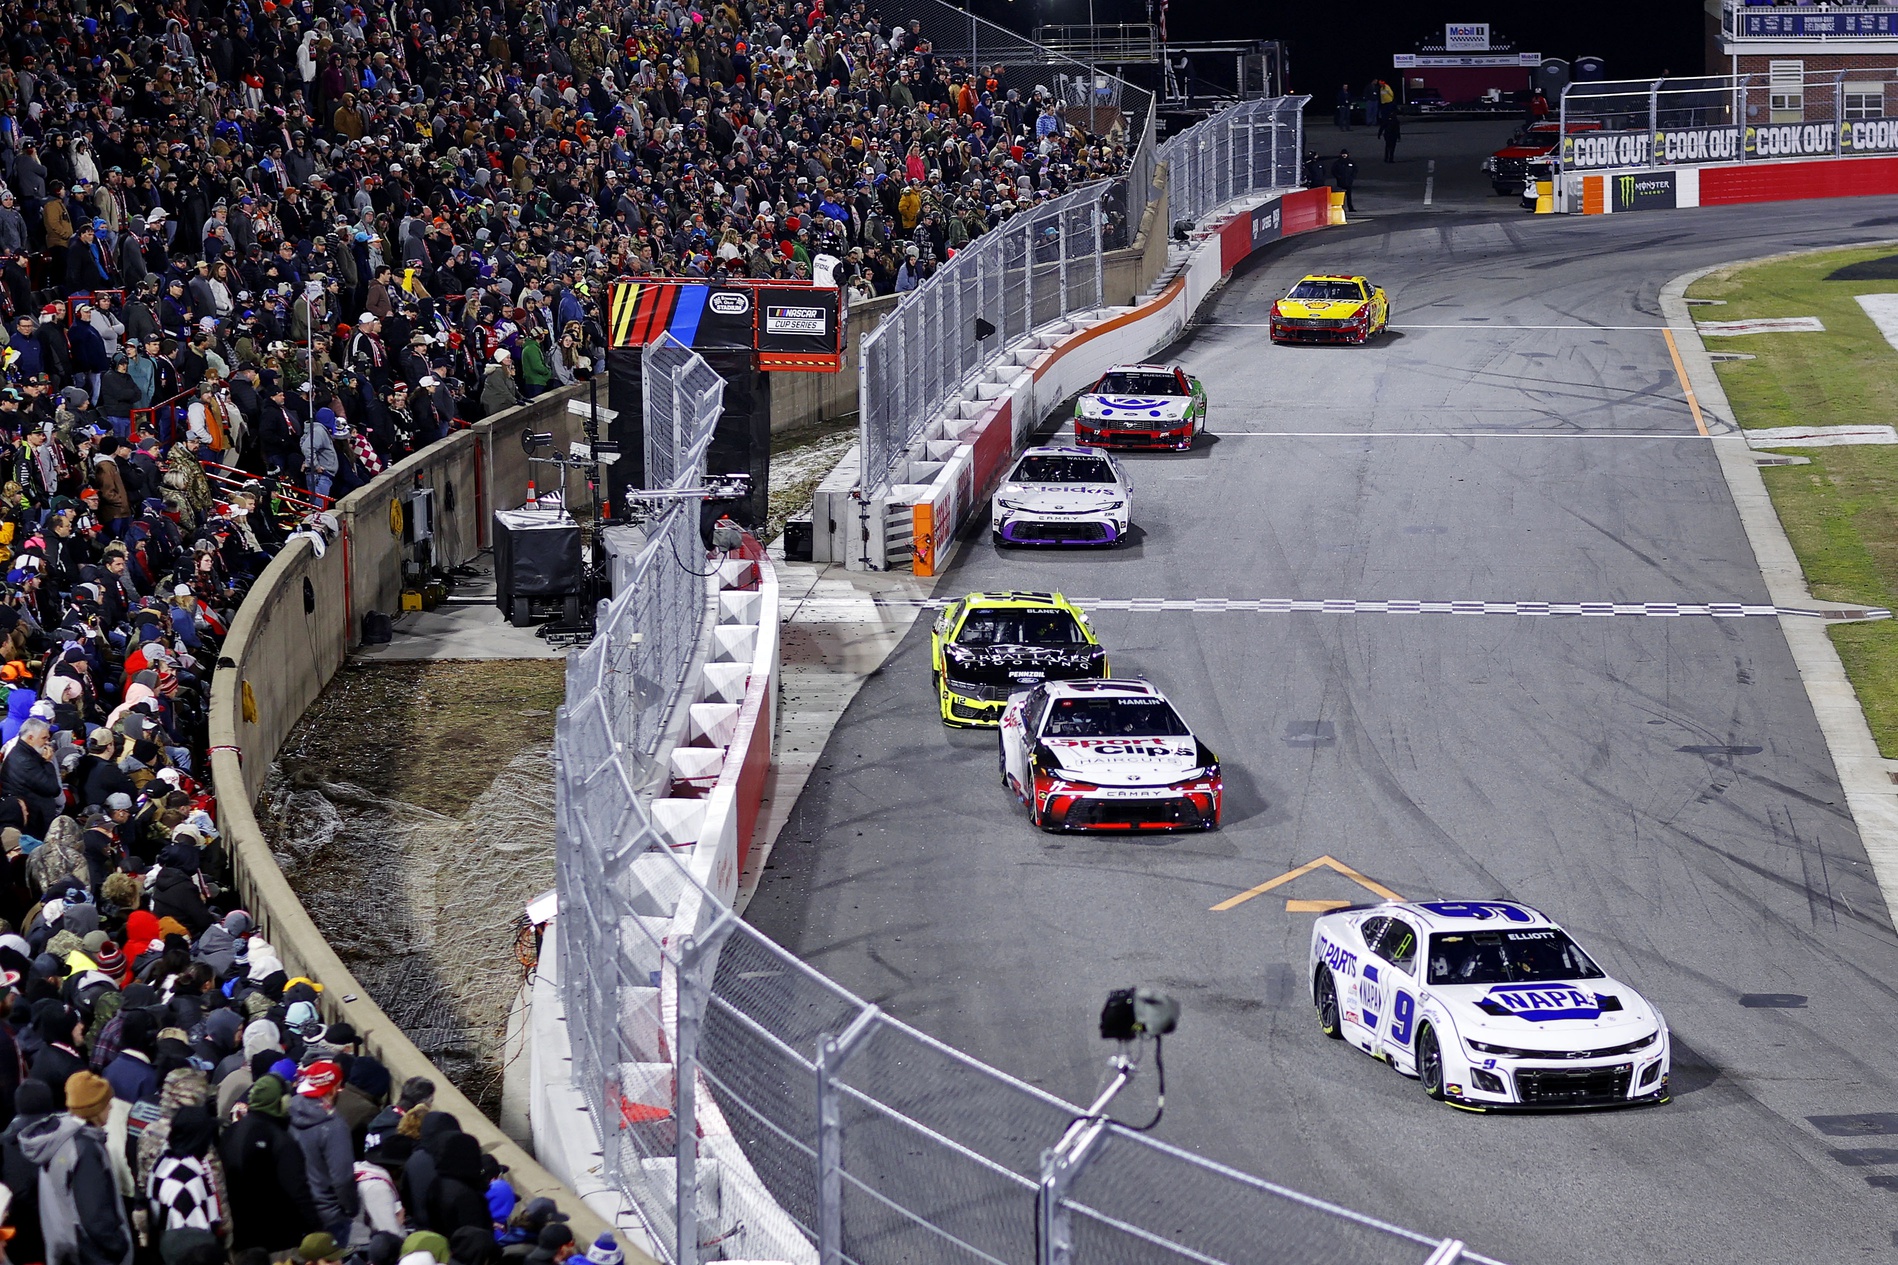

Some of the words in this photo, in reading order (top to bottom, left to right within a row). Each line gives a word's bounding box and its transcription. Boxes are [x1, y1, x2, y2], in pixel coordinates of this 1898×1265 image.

[1450, 27, 1475, 36] Mobil
[1804, 23, 1835, 31] FIELDHOUSE
[1665, 130, 1708, 160] COOK
[1709, 129, 1738, 158] OUT
[1756, 126, 1802, 155] COOK
[1803, 124, 1834, 153] OUT
[1573, 136, 1619, 167] COOK
[1619, 134, 1649, 164] OUT
[1635, 180, 1670, 191] MONSTER
[785, 309, 818, 318] NASCAR
[775, 320, 791, 328] CUP
[791, 320, 818, 329] SERIES
[956, 697, 966, 705] 12
[1050, 737, 1167, 749] Sport
[1093, 744, 1196, 757] Clips
[1079, 756, 1179, 766] HAIRCUTS
[1106, 789, 1162, 797] CAMRY
[1507, 931, 1556, 941] ELLIOTT
[1325, 943, 1358, 979] PARTS
[1361, 979, 1381, 1013] NAPA
[1499, 989, 1596, 1010] NAPA
[1391, 989, 1416, 1047] 9
[1481, 1058, 1497, 1070] 9
